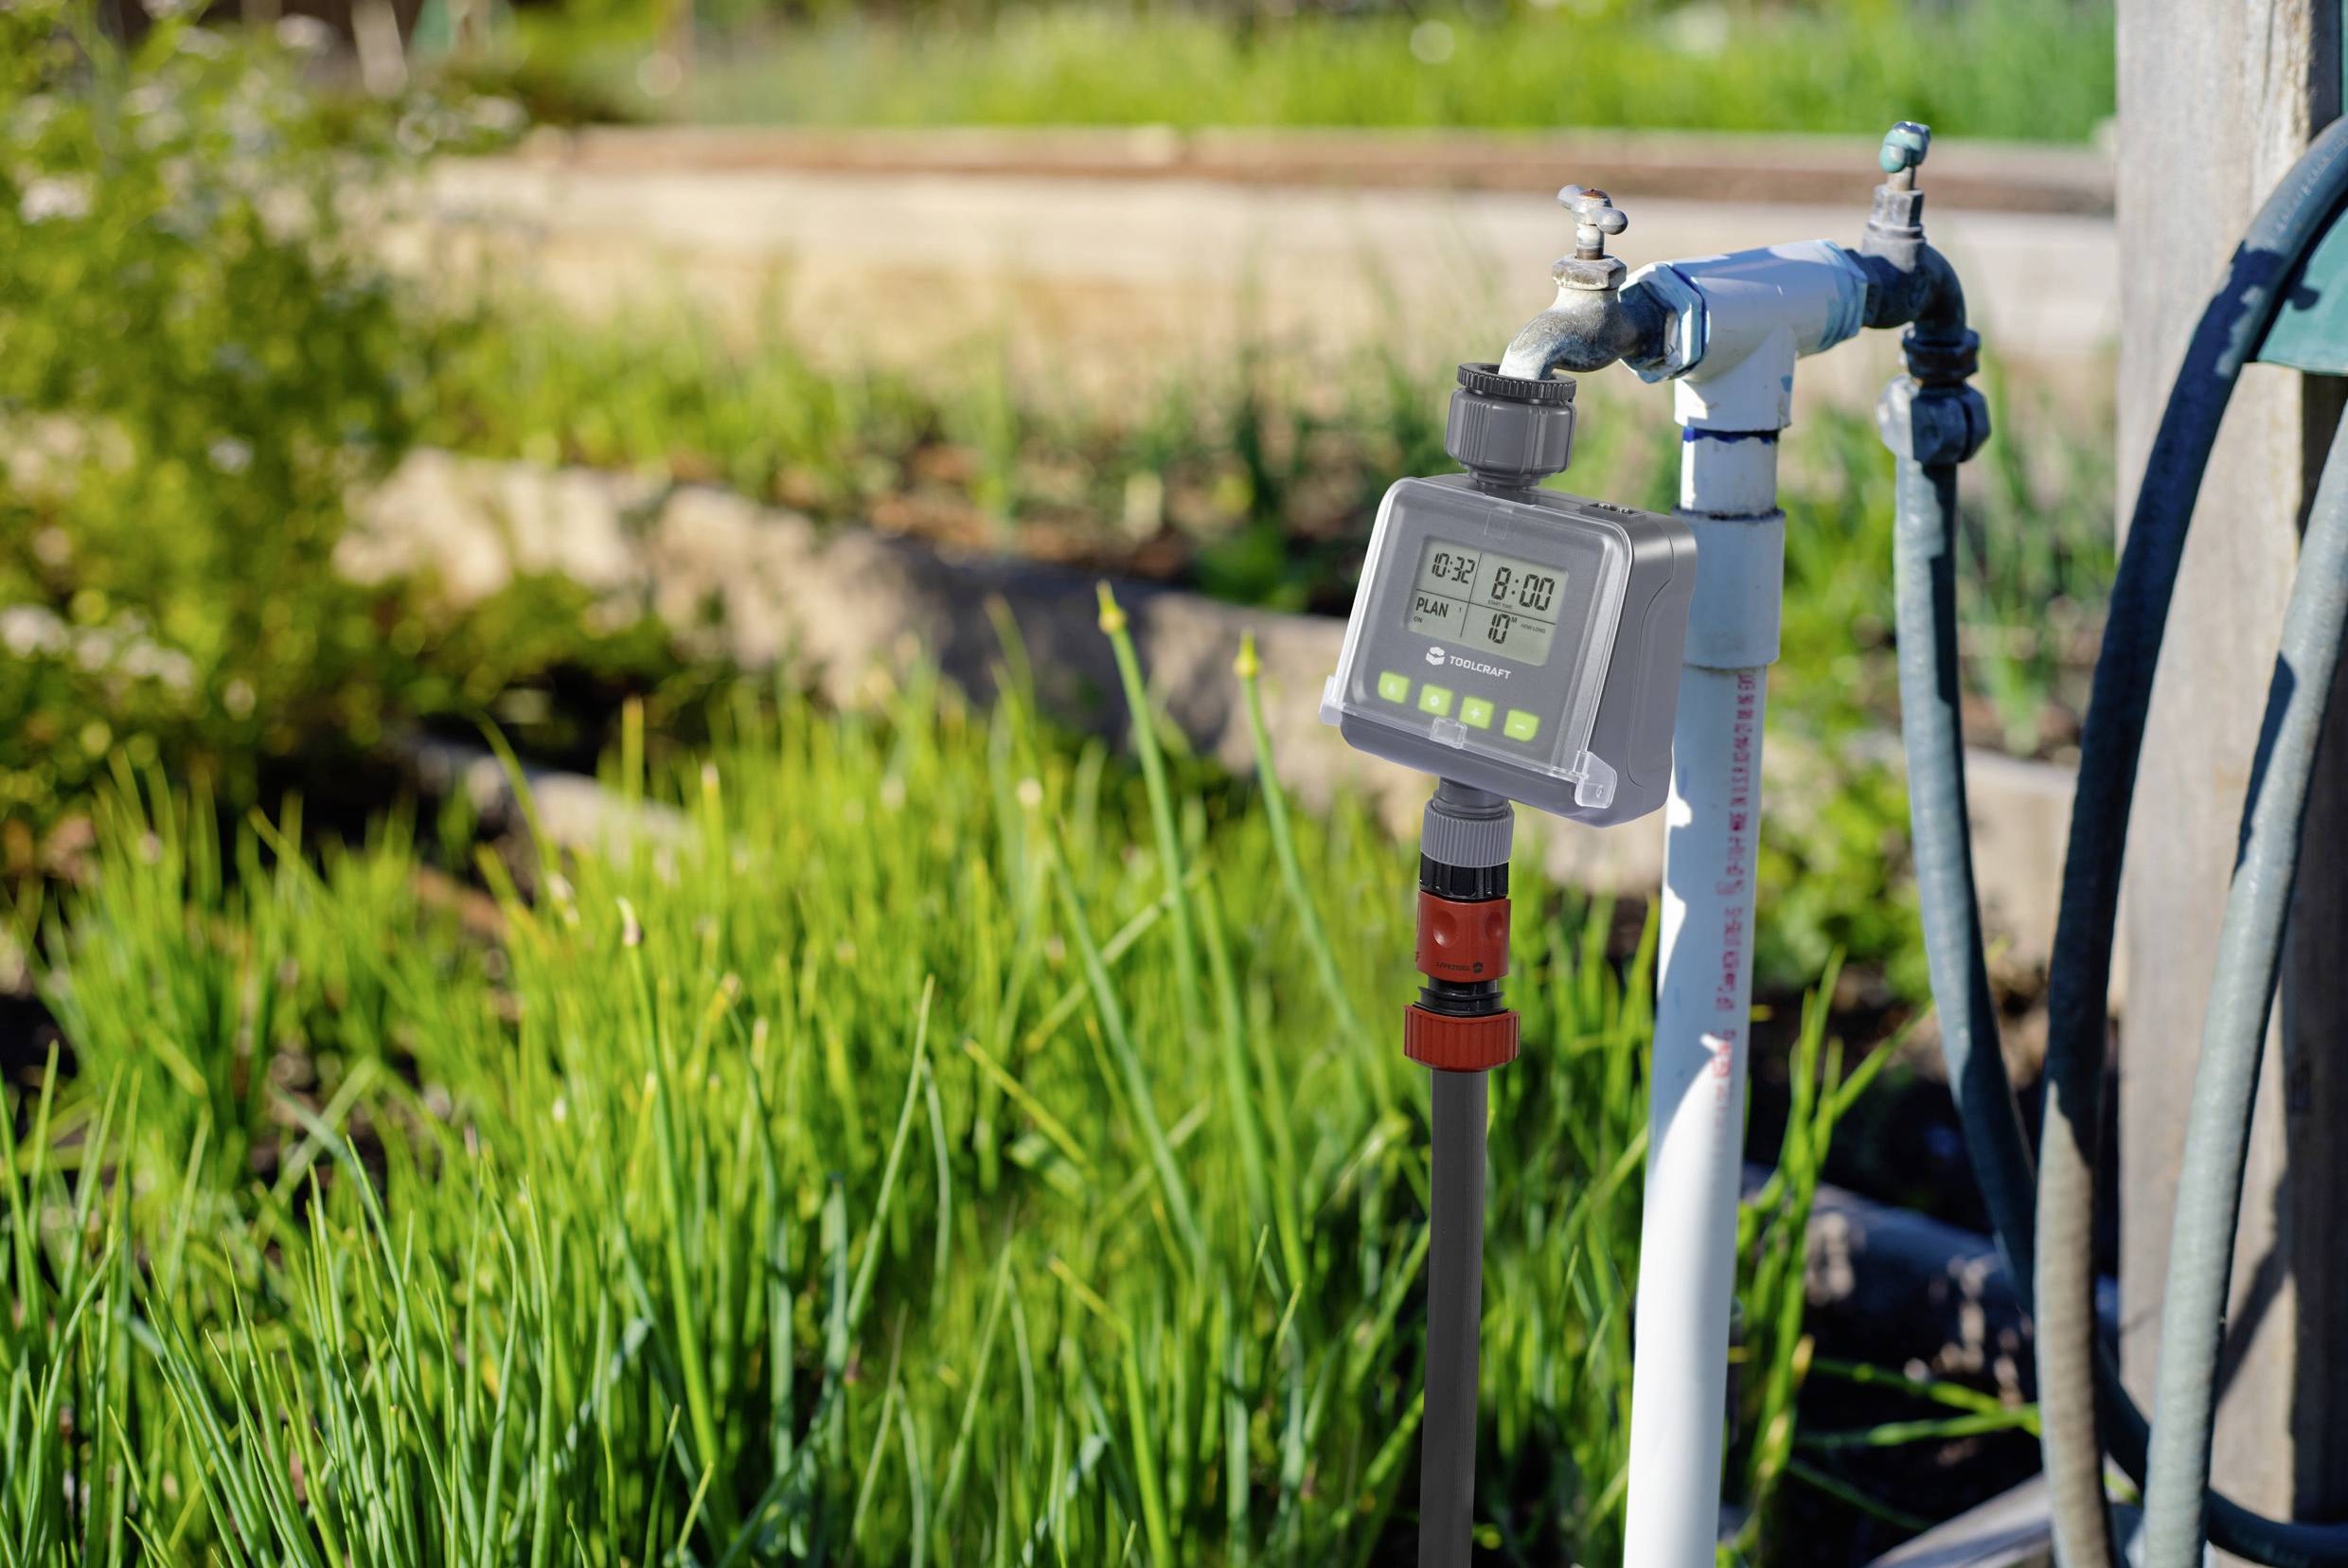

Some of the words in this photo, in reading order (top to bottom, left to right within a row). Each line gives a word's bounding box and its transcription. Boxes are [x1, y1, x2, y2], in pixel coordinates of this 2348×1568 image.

[1432, 552, 1476, 584] 10:32
[1490, 566, 1556, 612] 8:00
[1413, 615, 1423, 624] ON
[1415, 597, 1450, 618] PLAN
[1487, 614, 1511, 645] 10
[1449, 655, 1512, 680] TOOLCRAFT
